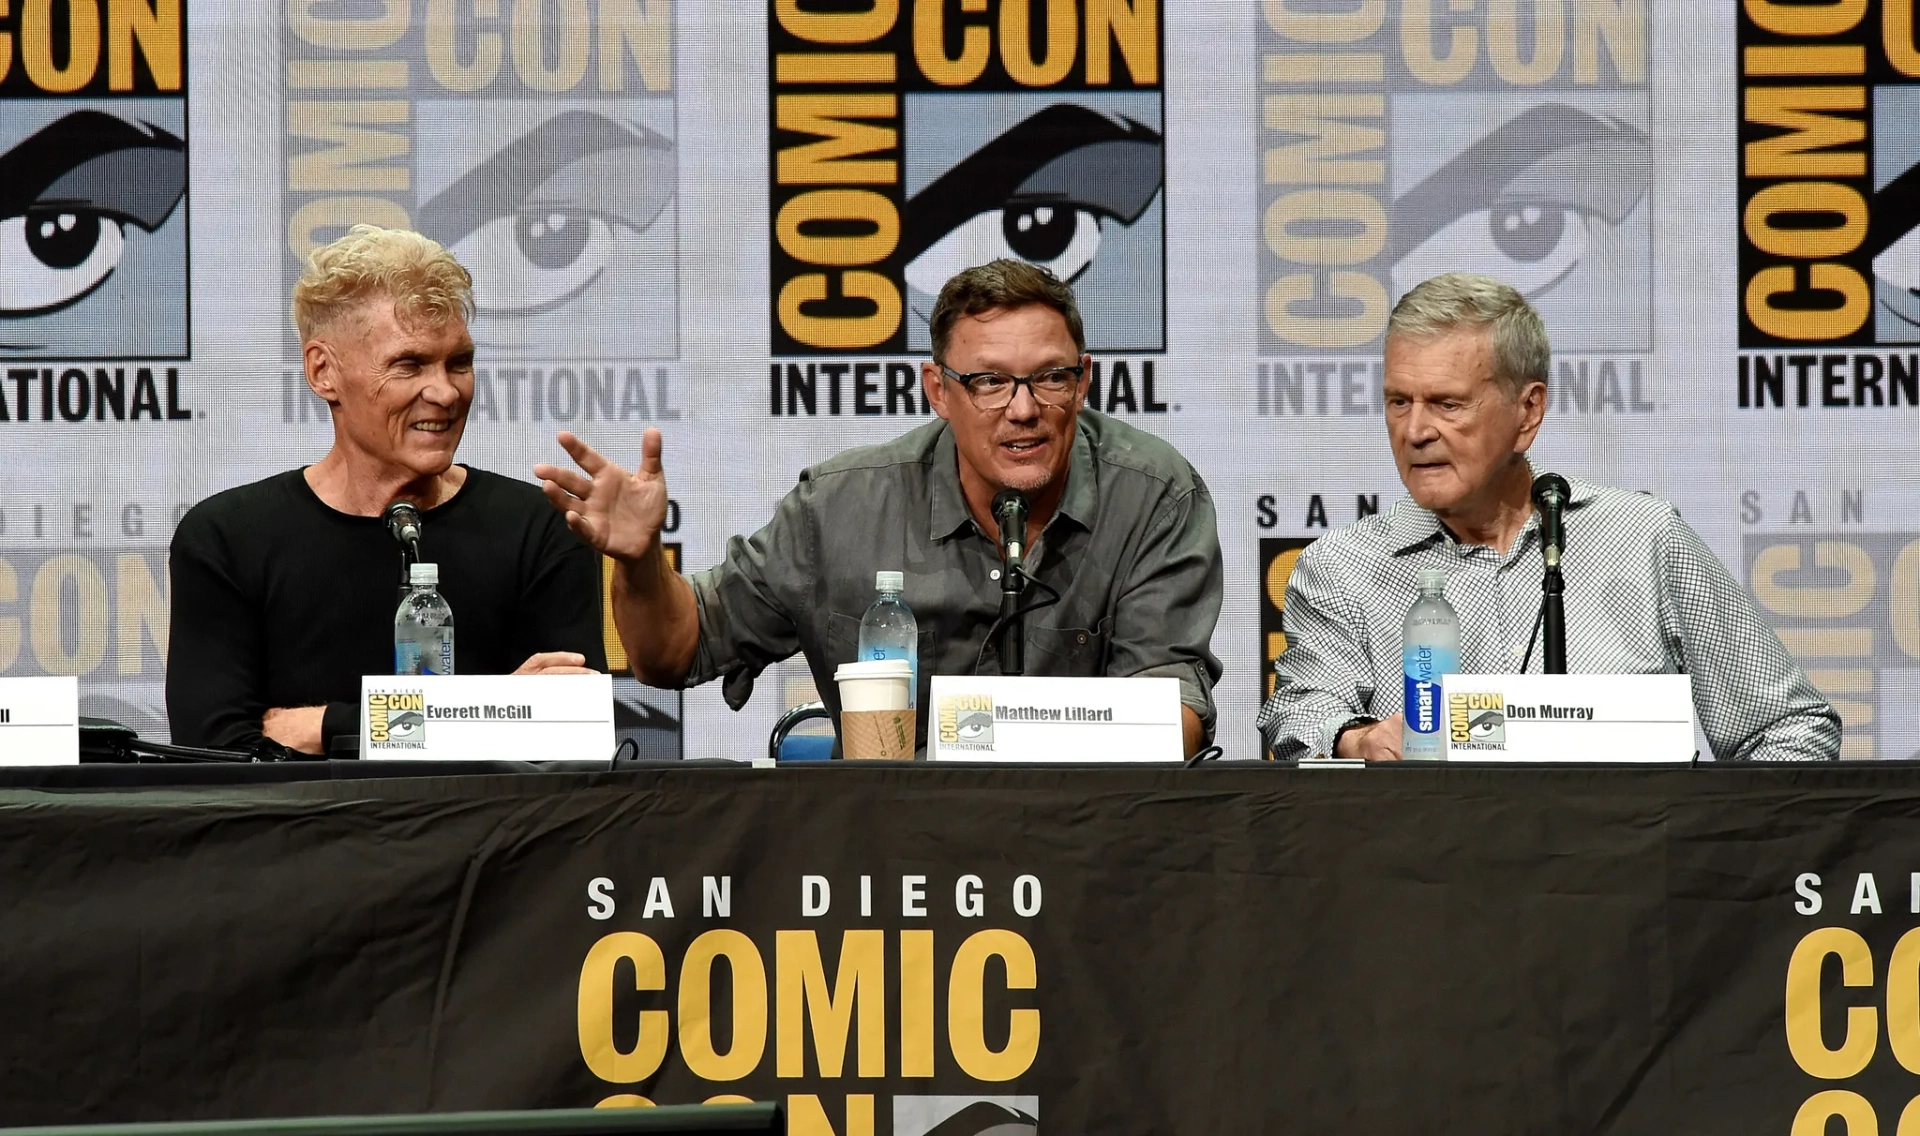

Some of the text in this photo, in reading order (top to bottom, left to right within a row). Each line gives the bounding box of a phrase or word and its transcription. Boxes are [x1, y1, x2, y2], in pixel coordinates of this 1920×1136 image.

[0, 0, 181, 92] ON
[426, 0, 671, 92] CON
[914, 0, 1159, 86] CON
[1400, 0, 1646, 85] CON
[1741, 489, 1863, 525] SAN
[369, 695, 389, 741] COMIC
[388, 694, 424, 710] CON
[426, 705, 532, 719] Everett McGill
[958, 695, 992, 711] CON
[995, 705, 1113, 722] Matthew Lillard
[1449, 693, 1470, 741] COMIC
[1468, 693, 1503, 710] CON
[1506, 704, 1594, 720] Don Murray
[587, 875, 1043, 920] SAN DIEGO
[577, 929, 1040, 1082] COMIC
